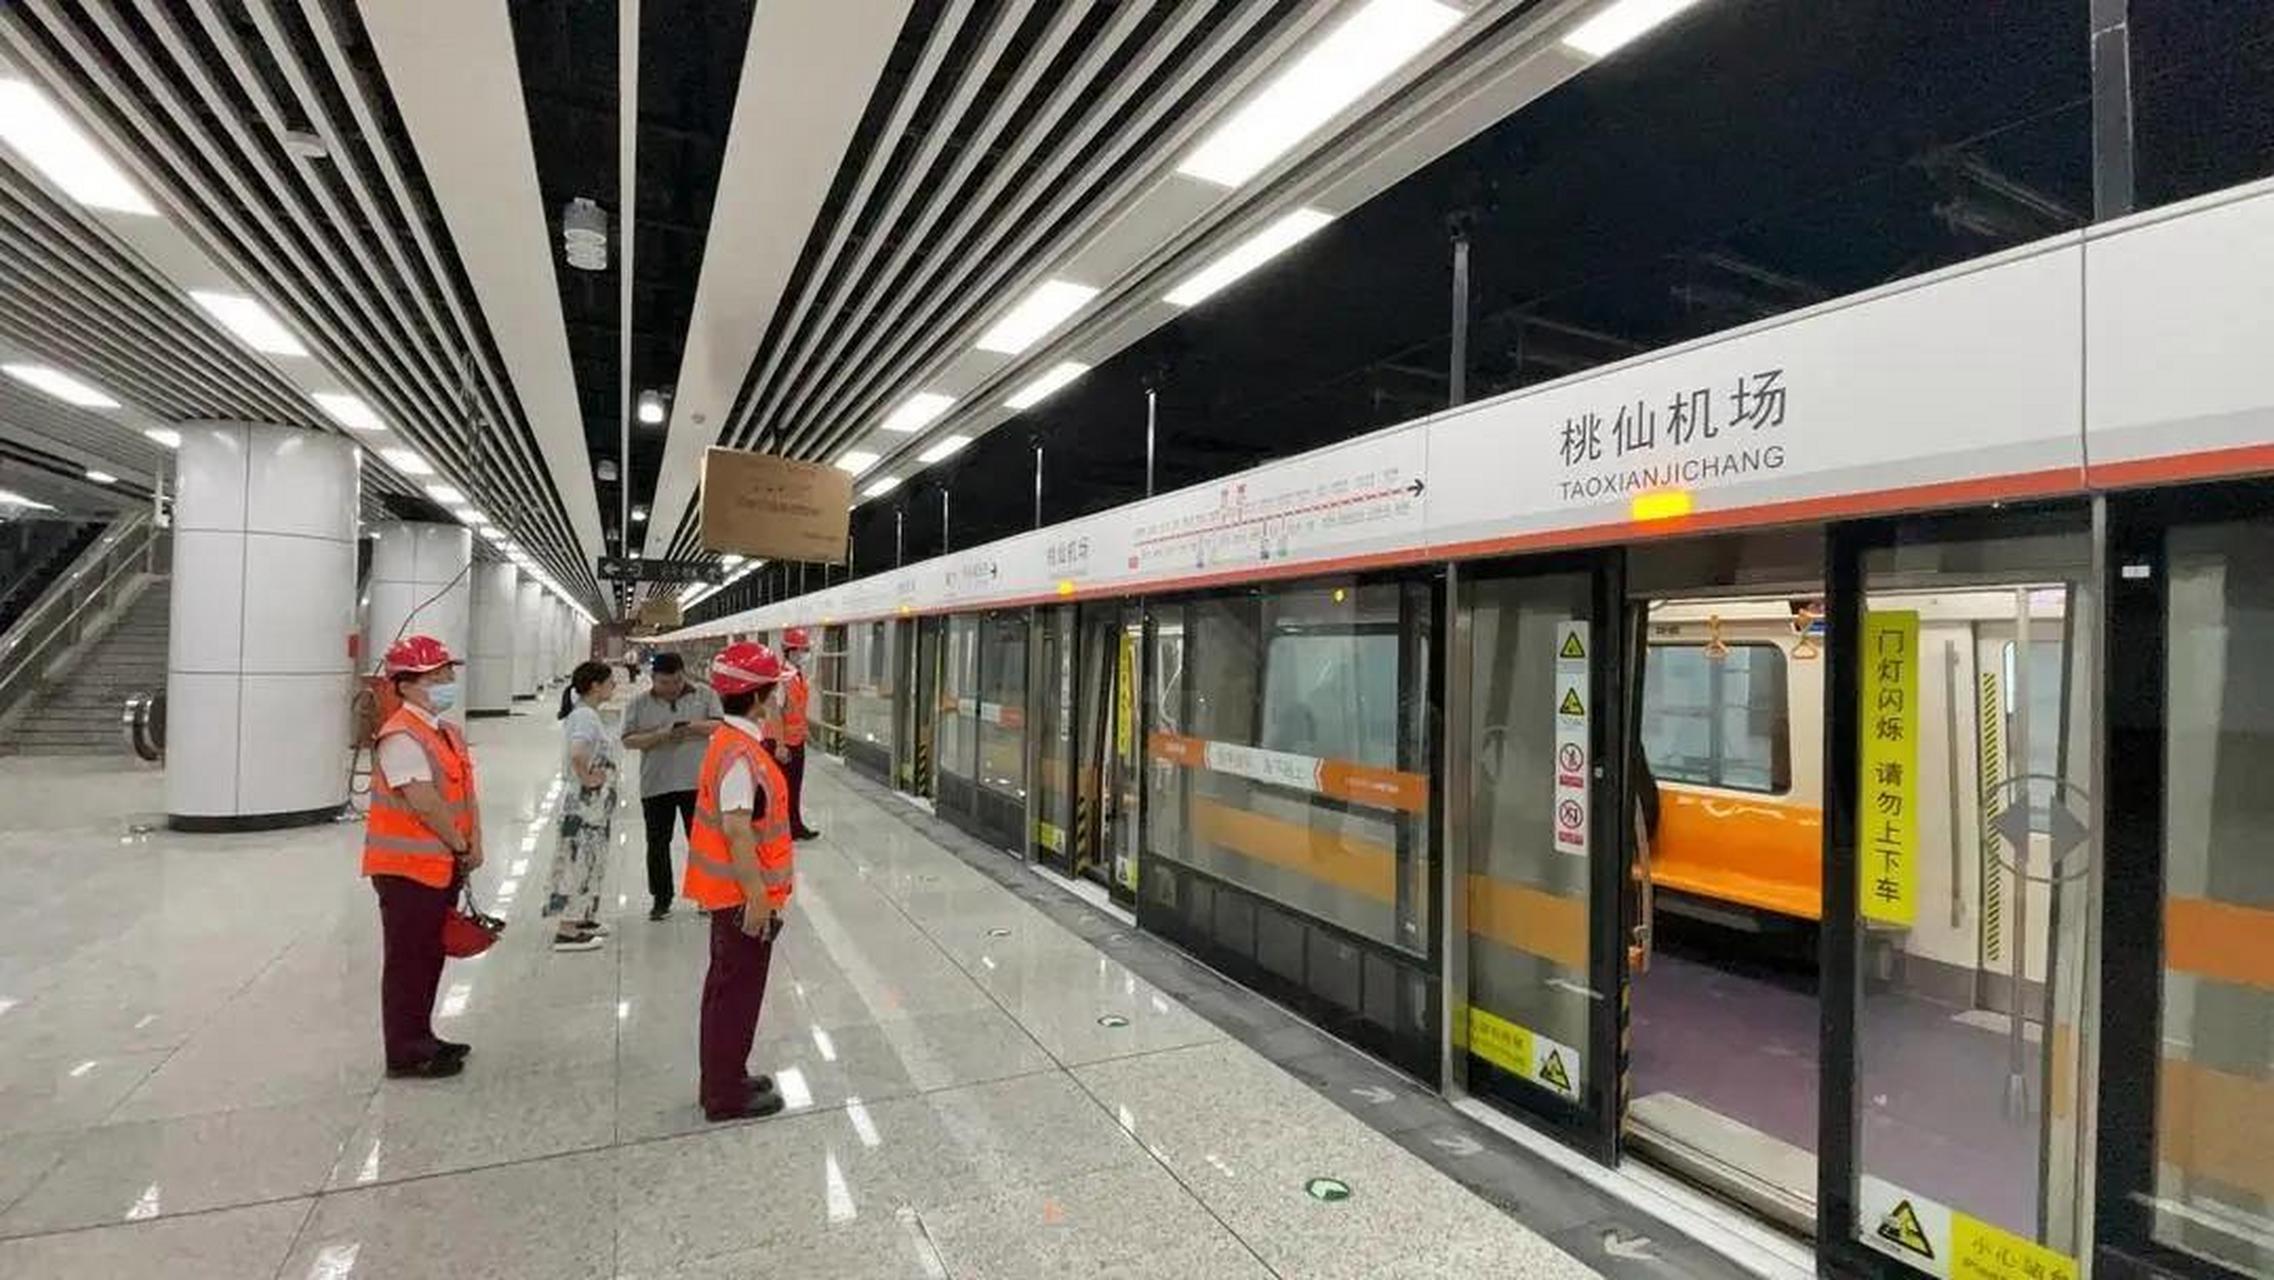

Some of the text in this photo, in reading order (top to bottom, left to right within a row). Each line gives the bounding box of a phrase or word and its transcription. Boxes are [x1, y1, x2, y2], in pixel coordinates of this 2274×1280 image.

[1560, 369, 1786, 466] 桃仙机场
[1560, 446, 1785, 500] TAOXIANJICHANG
[1874, 630, 1904, 902] 门灯闪烁 请勿上下车
